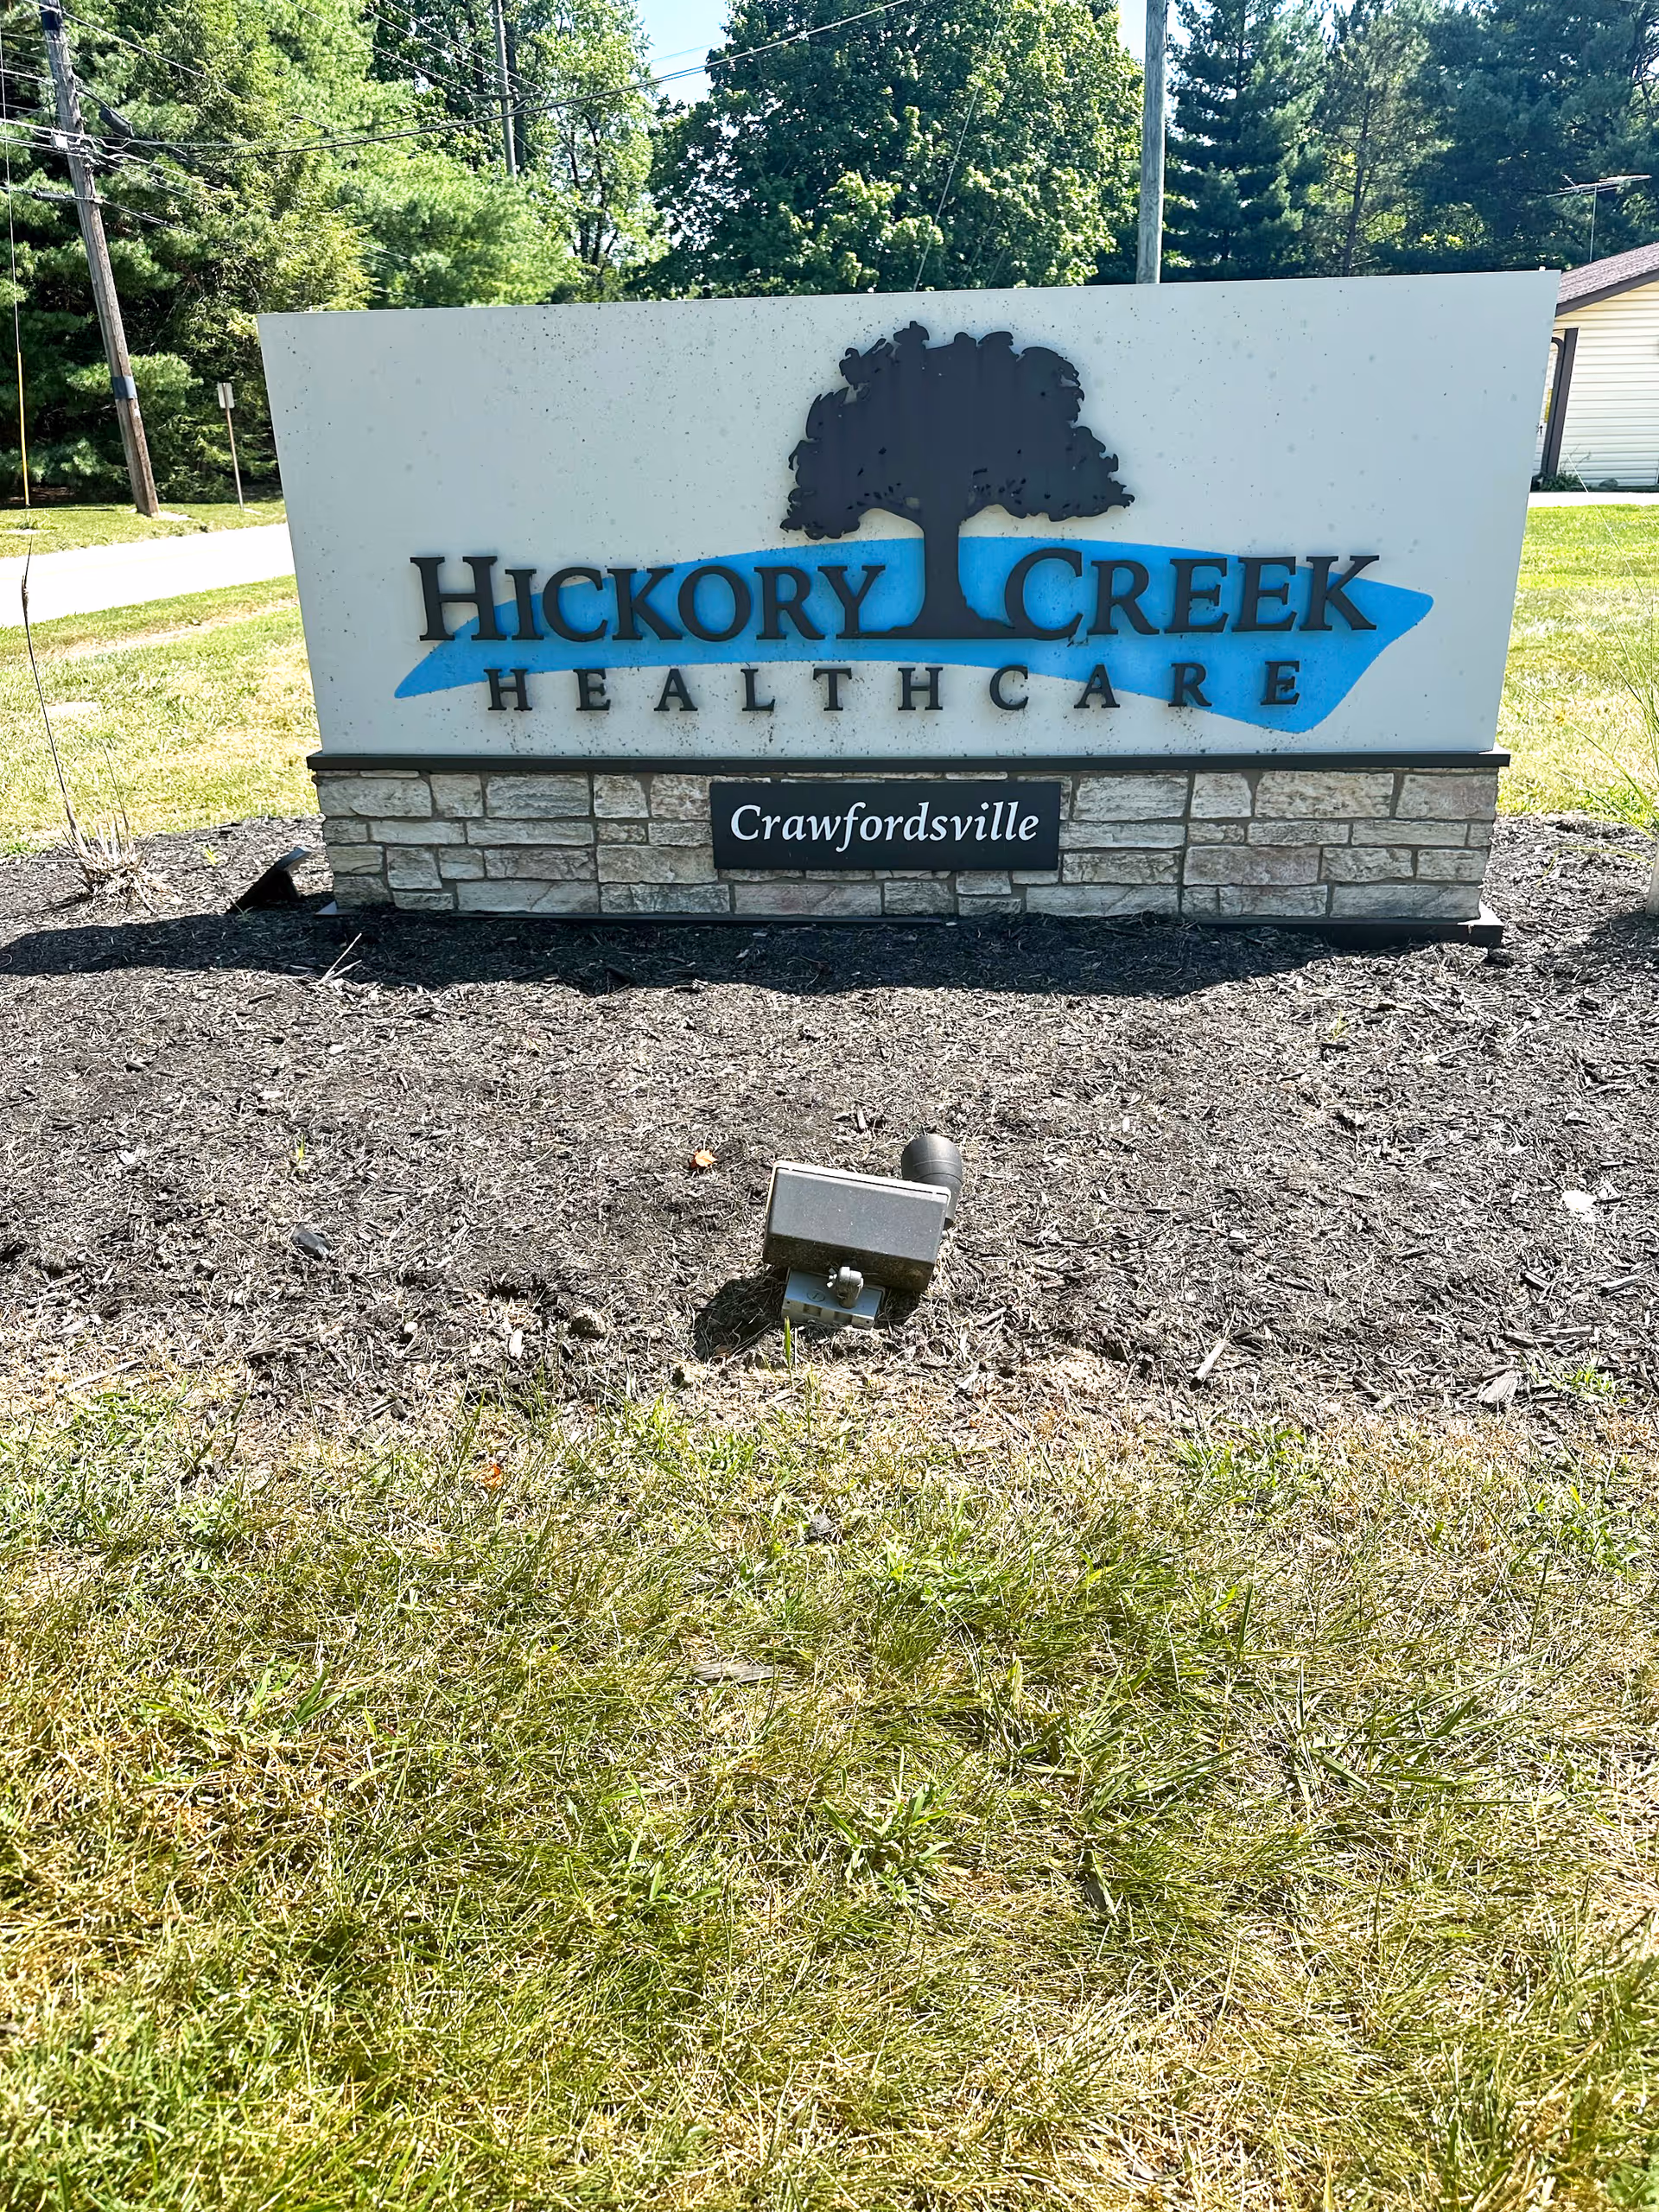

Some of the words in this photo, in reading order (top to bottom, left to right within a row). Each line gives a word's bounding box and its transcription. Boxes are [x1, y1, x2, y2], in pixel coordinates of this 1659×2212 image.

[410, 556, 887, 642] HICKORY
[1004, 548, 1381, 641] CREEK
[483, 660, 1301, 712] HEALTHCARE
[729, 801, 1039, 853] Crawfordsville
